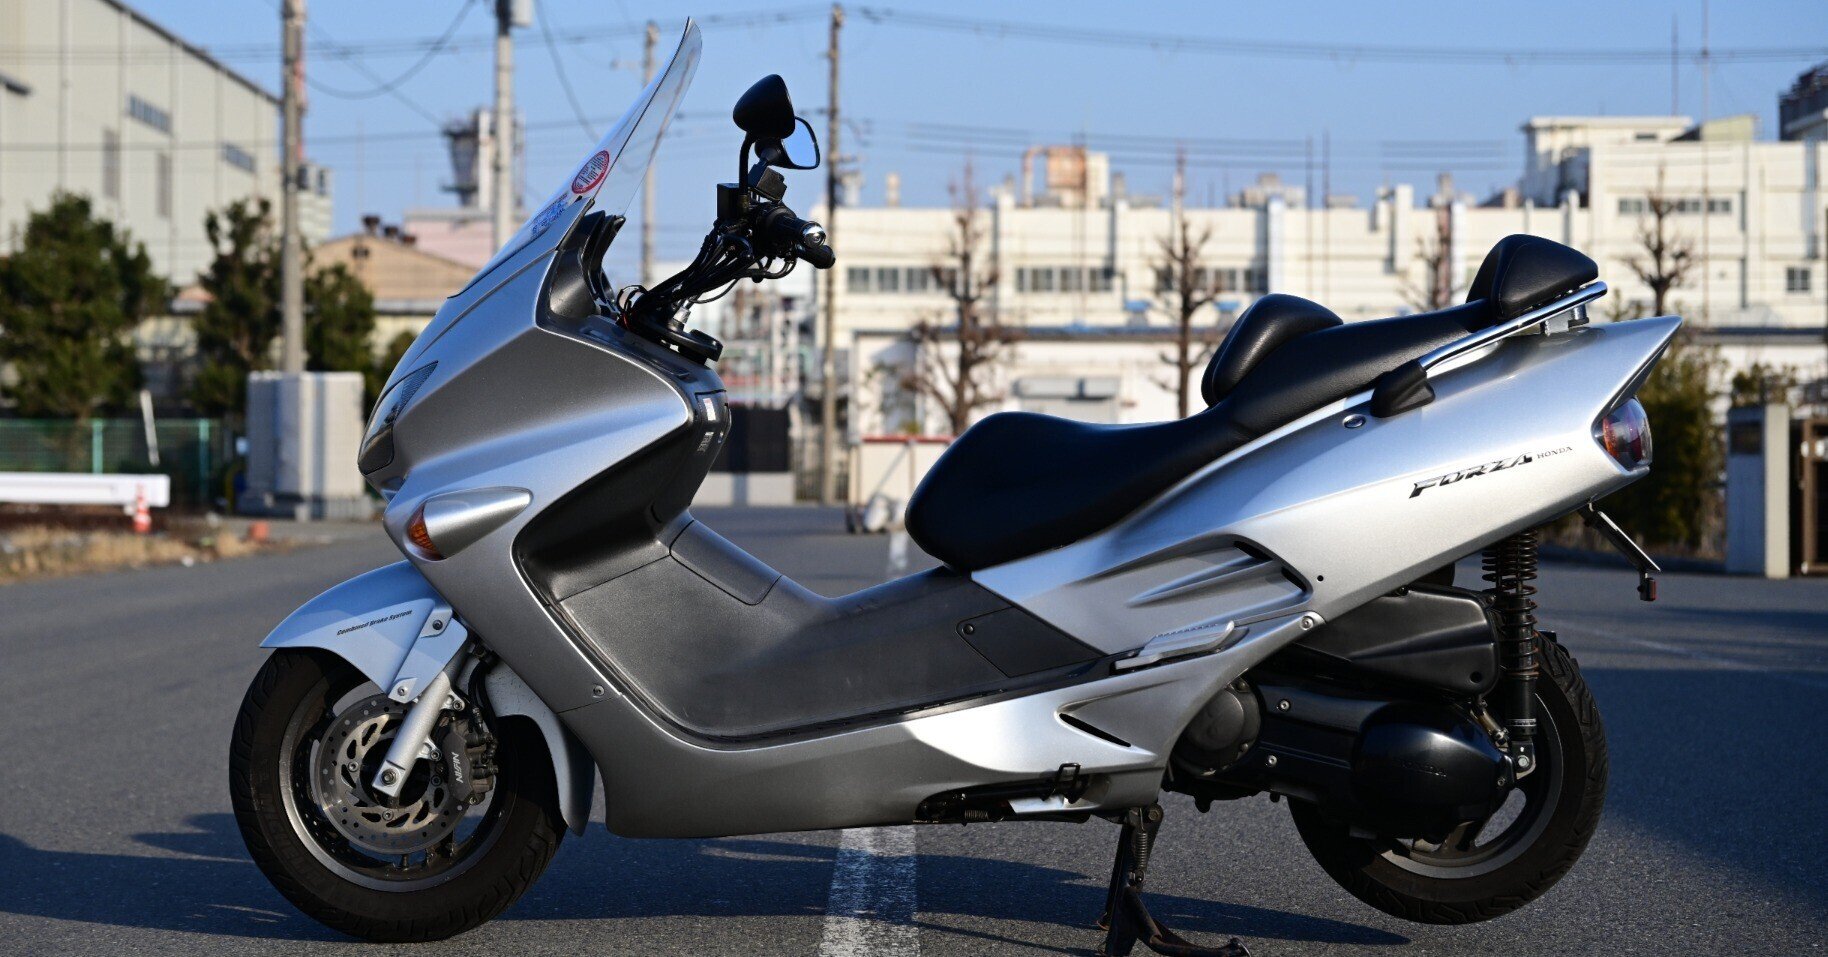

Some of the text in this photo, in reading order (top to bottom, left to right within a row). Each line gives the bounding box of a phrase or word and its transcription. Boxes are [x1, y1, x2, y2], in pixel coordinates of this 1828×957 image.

[1409, 446, 1573, 499] FORZA HONDA
[337, 610, 413, 635] Combined Brake System
